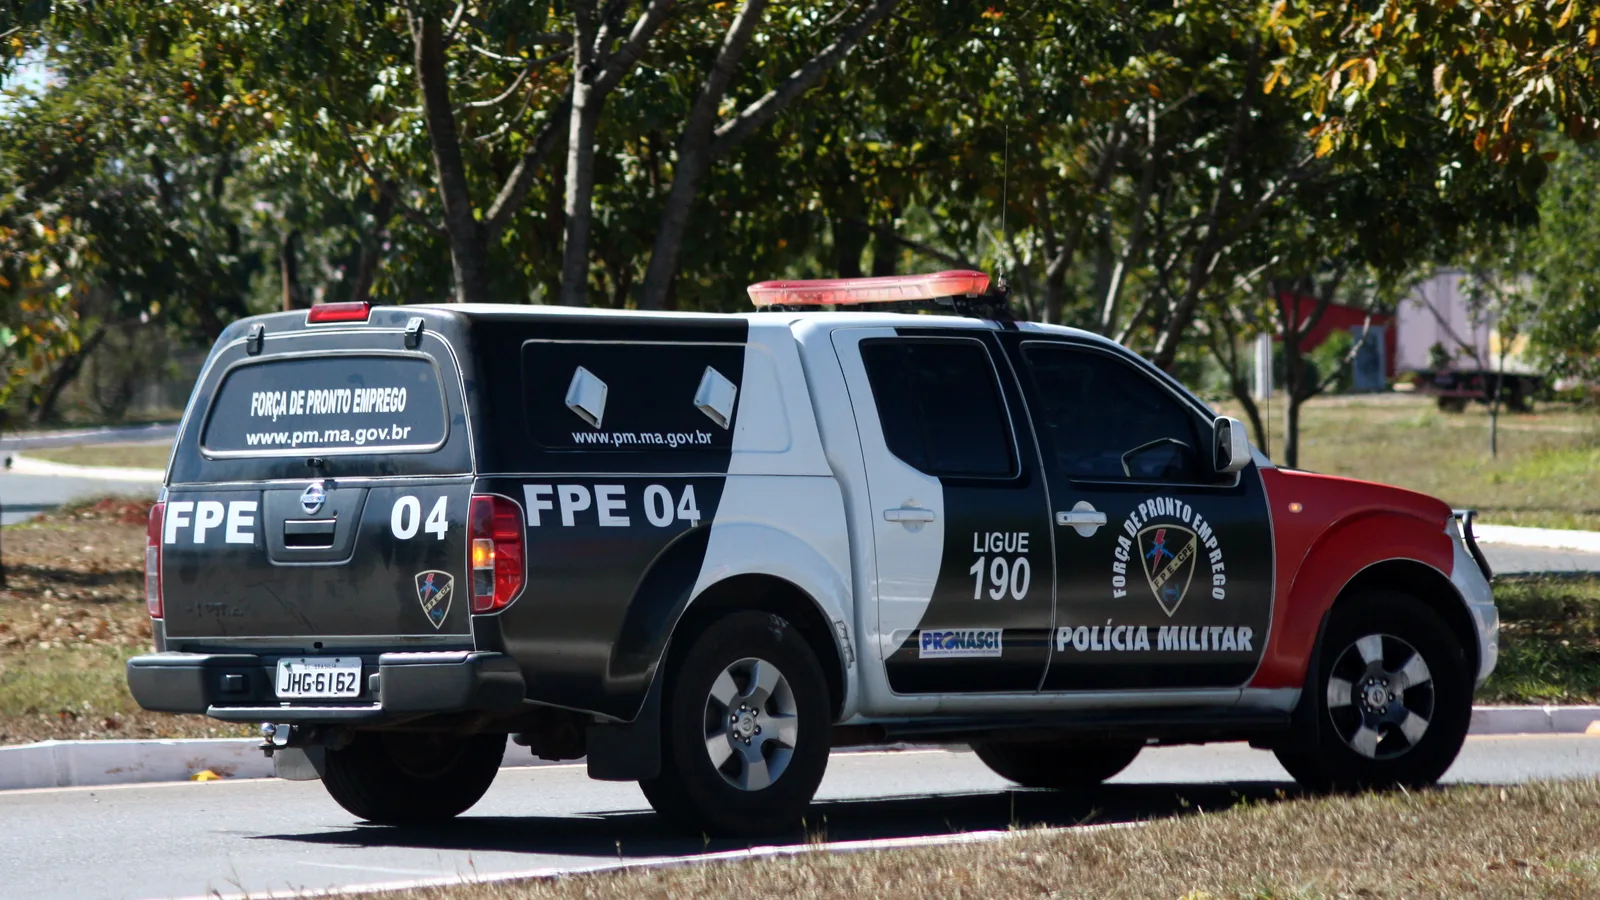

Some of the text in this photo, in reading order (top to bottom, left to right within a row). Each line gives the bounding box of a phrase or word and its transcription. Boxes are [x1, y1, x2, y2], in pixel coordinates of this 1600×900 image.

[250, 387, 407, 422] FORÇA DE PRONTO EMPREGO
[246, 424, 412, 447] www.pm.ma.gov.br
[572, 430, 712, 448] www.pm.ma.gov.br
[164, 495, 449, 544] FPE 04
[523, 484, 700, 528] FPE 04
[973, 532, 1030, 553] LIGUE
[1112, 497, 1226, 600] FORÇA DE PRONTO EMPREGO
[970, 556, 1031, 600] 190
[922, 631, 1000, 650] PRONASCI
[1056, 618, 1253, 651] POLÍCIA MILITAR
